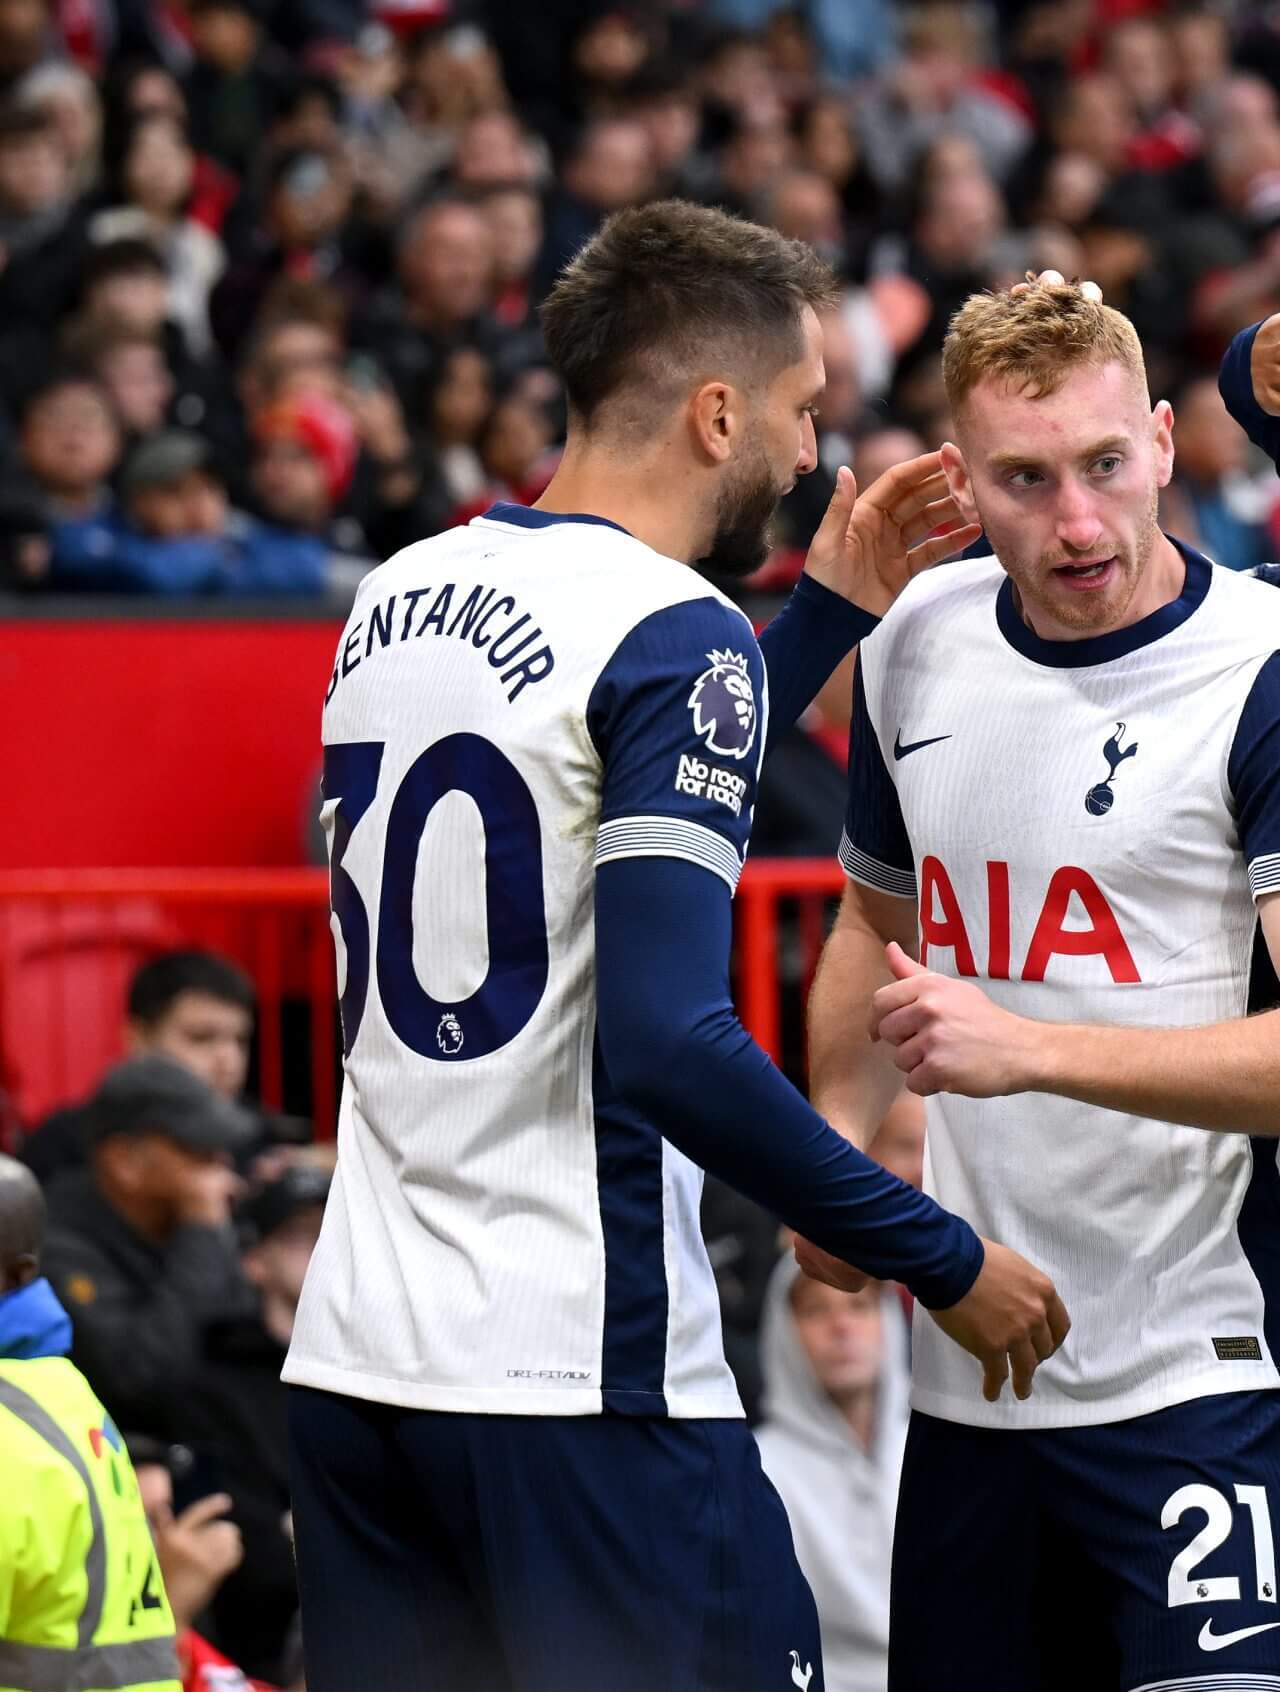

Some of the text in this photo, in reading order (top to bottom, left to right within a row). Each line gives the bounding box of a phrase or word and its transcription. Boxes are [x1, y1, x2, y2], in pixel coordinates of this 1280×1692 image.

[675, 773, 706, 797] for
[678, 754, 709, 780] No
[919, 855, 1142, 984] AIA
[1161, 1483, 1278, 1608] 21
